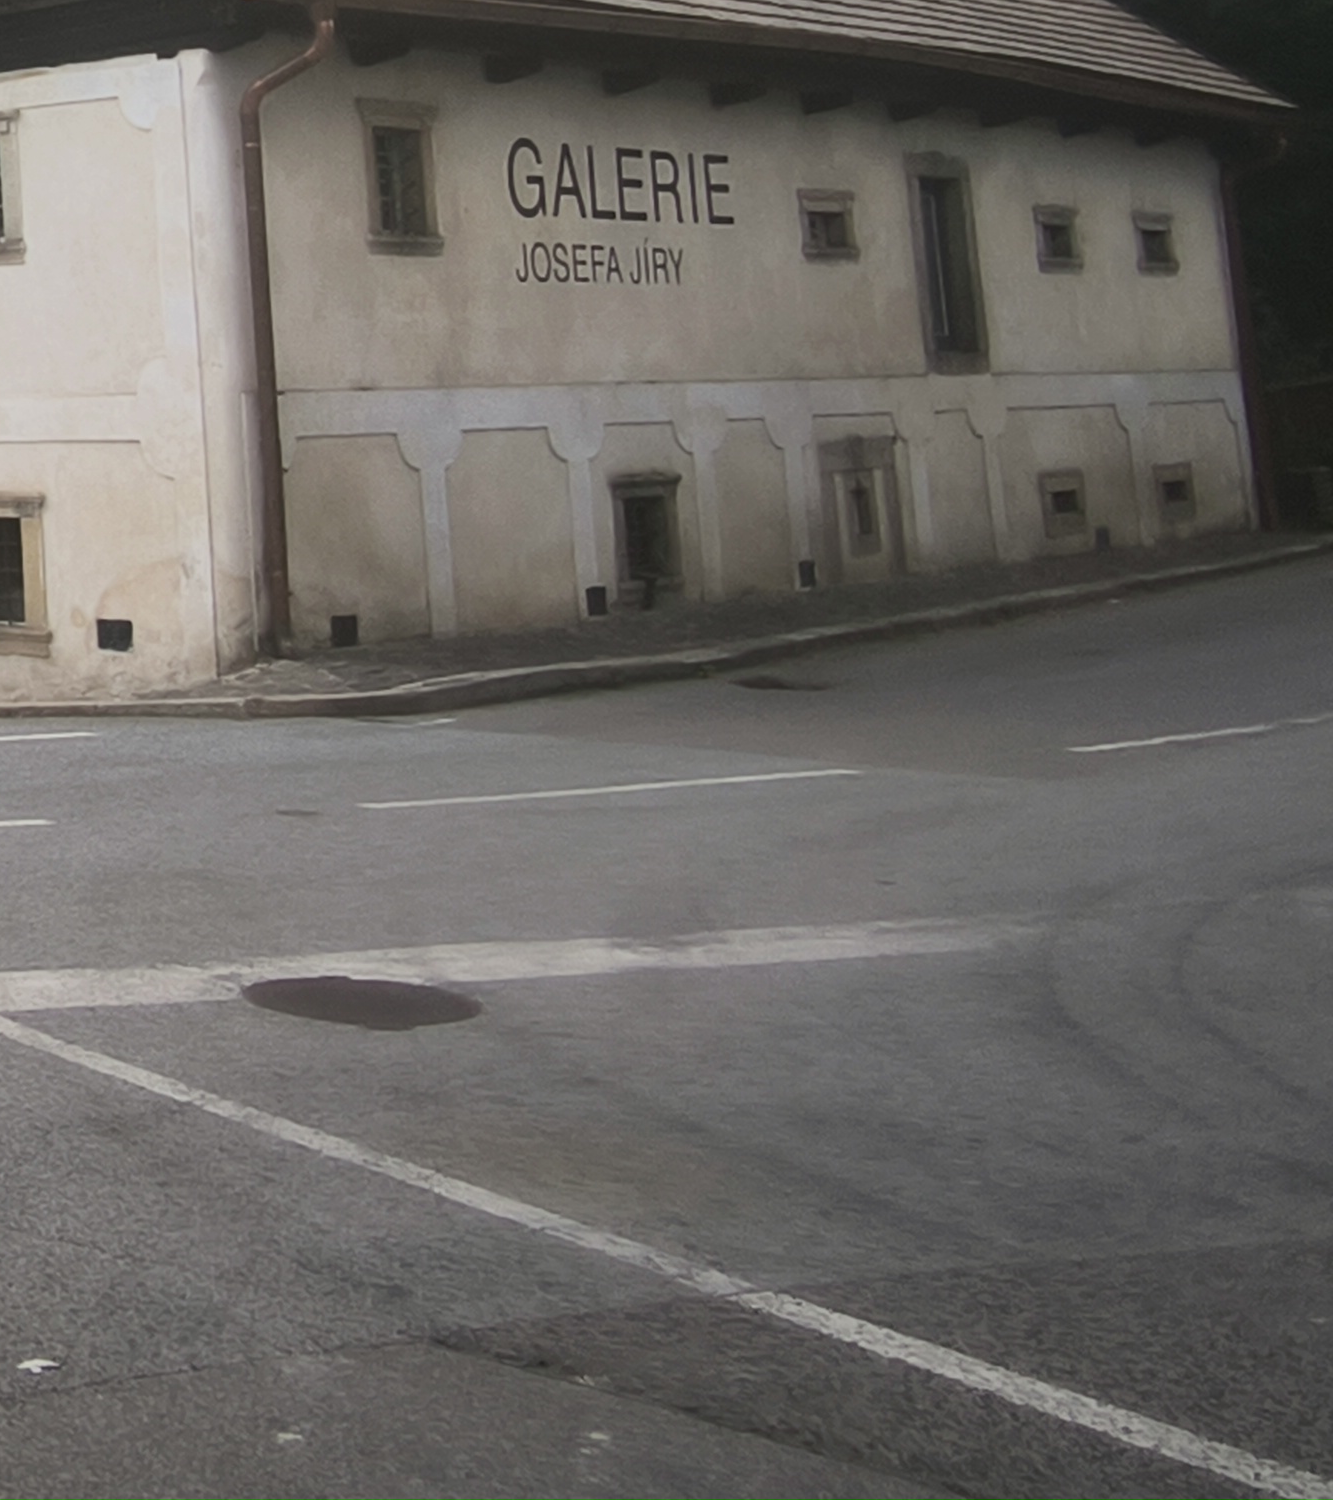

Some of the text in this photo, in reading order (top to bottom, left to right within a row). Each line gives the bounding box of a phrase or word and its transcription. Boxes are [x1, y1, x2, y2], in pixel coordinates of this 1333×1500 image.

[507, 137, 735, 225] GALERIE
[515, 238, 684, 285] JOSEFA JÍRY
